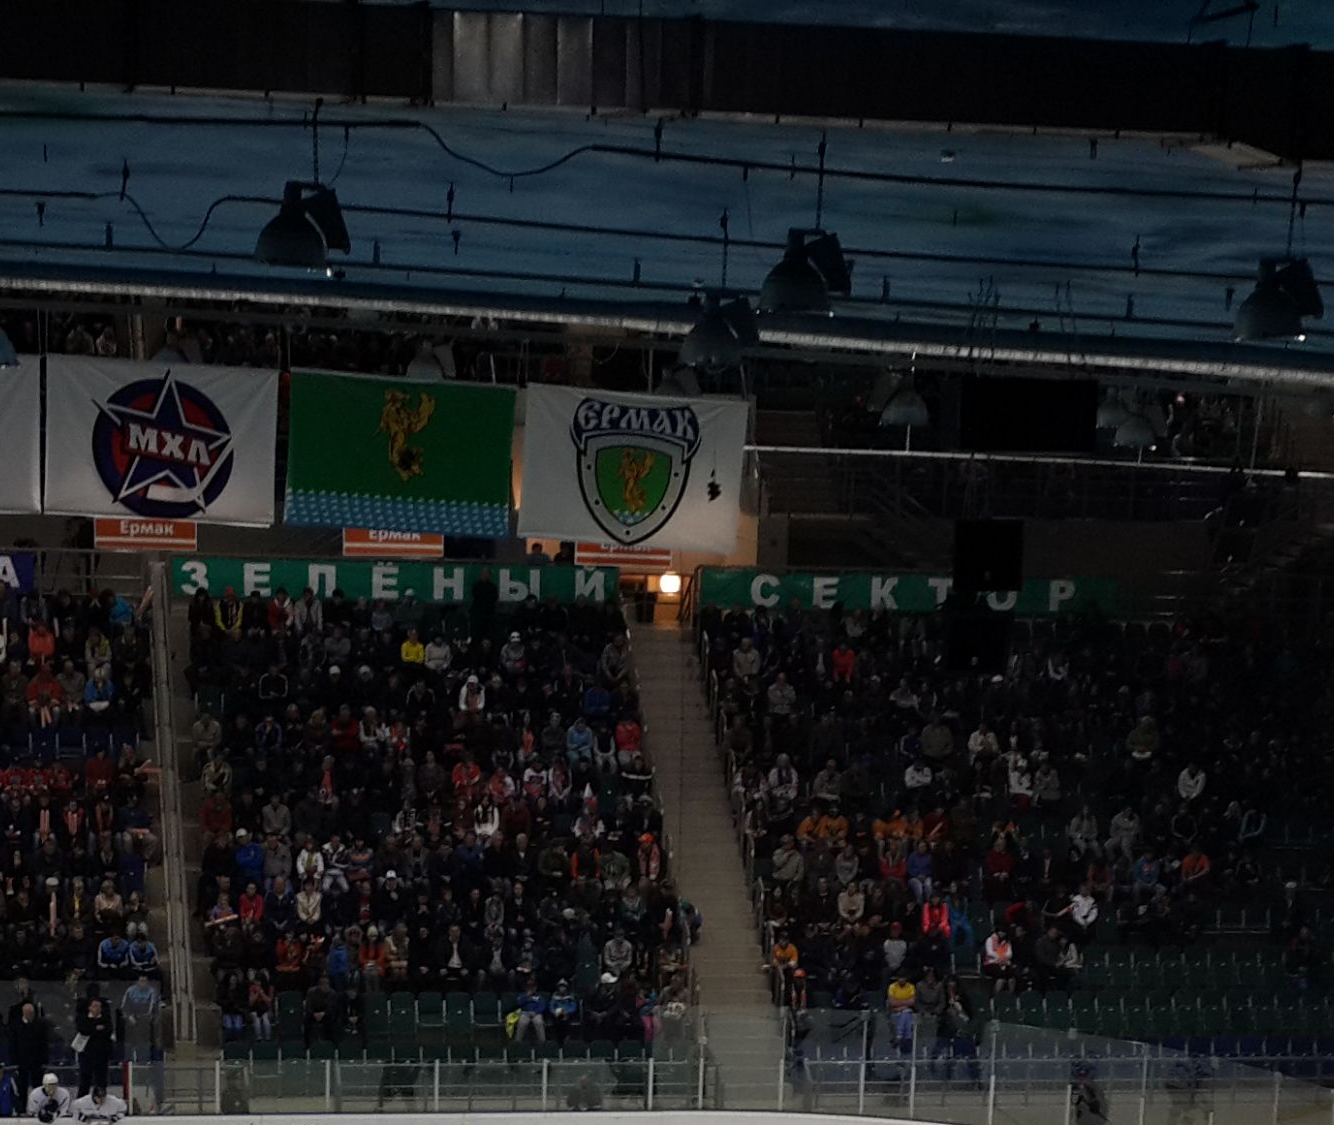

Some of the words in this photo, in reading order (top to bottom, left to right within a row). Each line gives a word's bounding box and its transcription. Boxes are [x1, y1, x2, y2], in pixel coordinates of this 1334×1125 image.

[127, 422, 211, 466] МХЛ
[120, 520, 174, 537] Ермак
[180, 560, 606, 602] ЗЕЛЁНЫЙ
